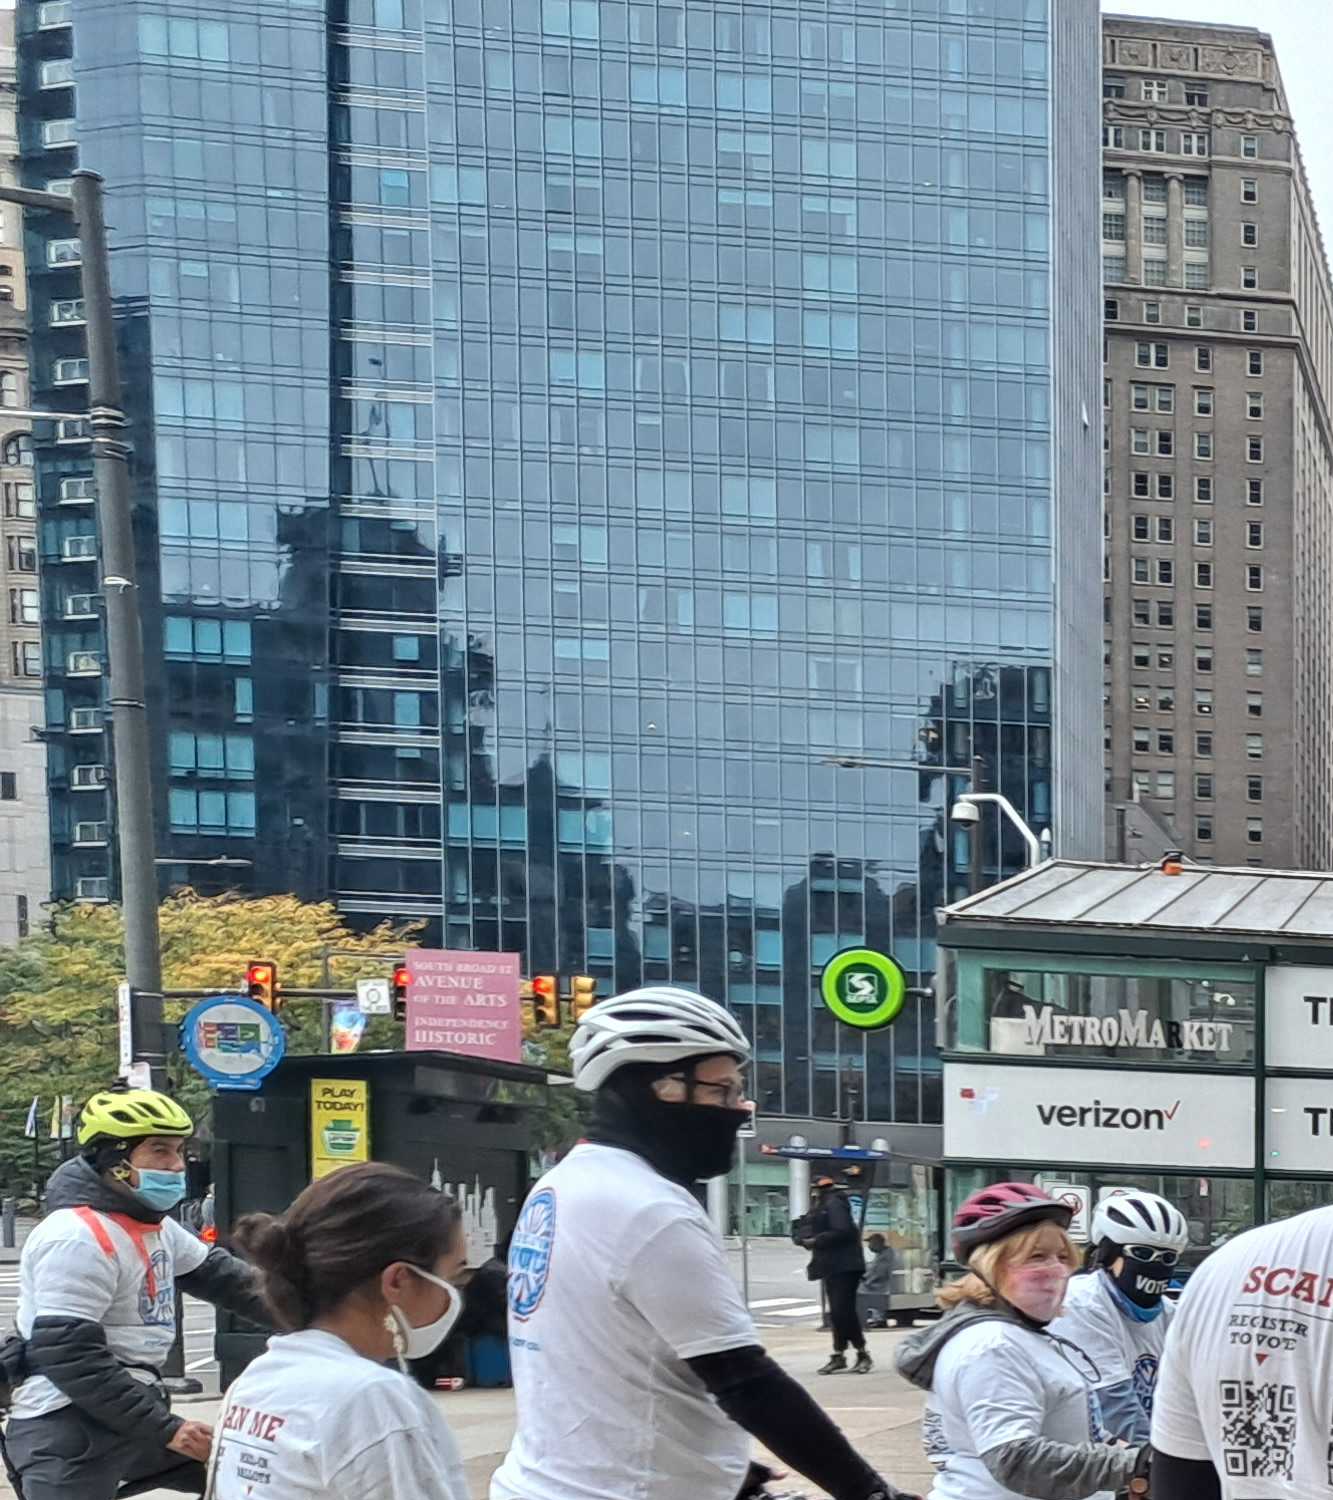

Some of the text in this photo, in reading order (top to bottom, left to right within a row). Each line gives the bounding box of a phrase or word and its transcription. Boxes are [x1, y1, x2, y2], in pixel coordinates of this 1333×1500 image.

[414, 975, 484, 989] AVENUE
[435, 995, 457, 1005] THE
[464, 993, 507, 1007] ARTS
[415, 1030, 497, 1045] HISTORIC
[321, 1087, 357, 1098] PLAY
[315, 1100, 364, 1112] TODAY!
[1036, 1099, 1165, 1130] verizon
[1136, 1275, 1169, 1295] VOTE
[1230, 1331, 1253, 1346] TO
[247, 1410, 285, 1442] ME
